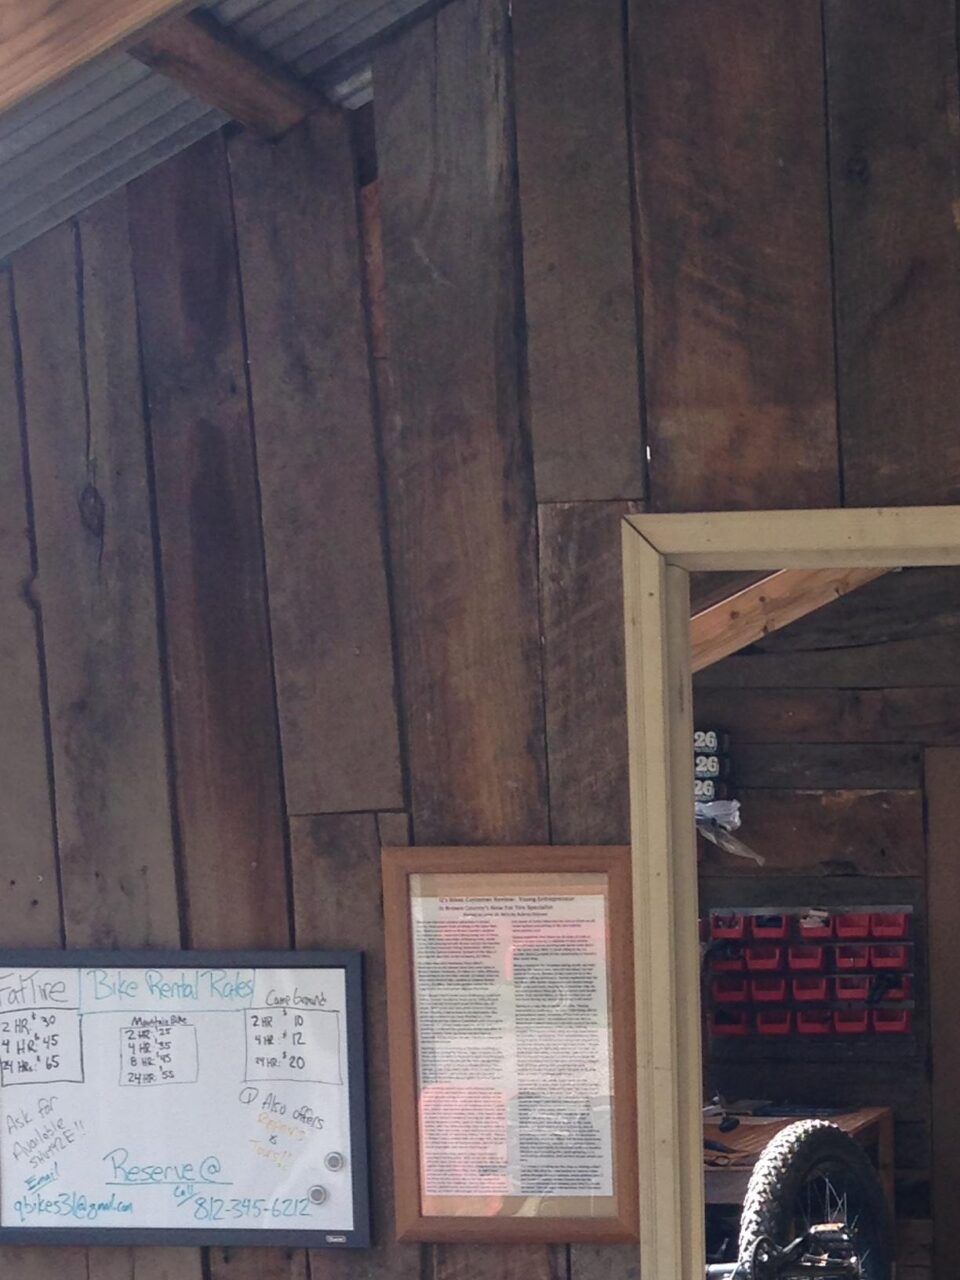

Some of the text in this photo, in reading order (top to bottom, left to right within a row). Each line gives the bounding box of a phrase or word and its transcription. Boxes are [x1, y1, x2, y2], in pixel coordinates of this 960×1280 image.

[694, 731, 717, 747] 26
[696, 755, 719, 772] 26
[694, 779, 714, 796] 26
[86, 968, 256, 1001] Bike Rental Rates
[2, 1021, 11, 1034] 2
[252, 1015, 260, 1028] 2
[124, 1030, 138, 1042] 2
[255, 1034, 262, 1046] 4
[1, 1038, 10, 1055] 4
[128, 1042, 137, 1056] 4
[130, 1055, 138, 1068] 8
[127, 1071, 142, 1085] 24
[6, 1095, 60, 1136] Ask for
[261, 1092, 287, 1115] Also
[292, 1104, 325, 1131] offers
[13, 1116, 66, 1161] Available
[102, 1148, 222, 1182] Reserve @
[193, 1196, 314, 1222] 812-345-6212
